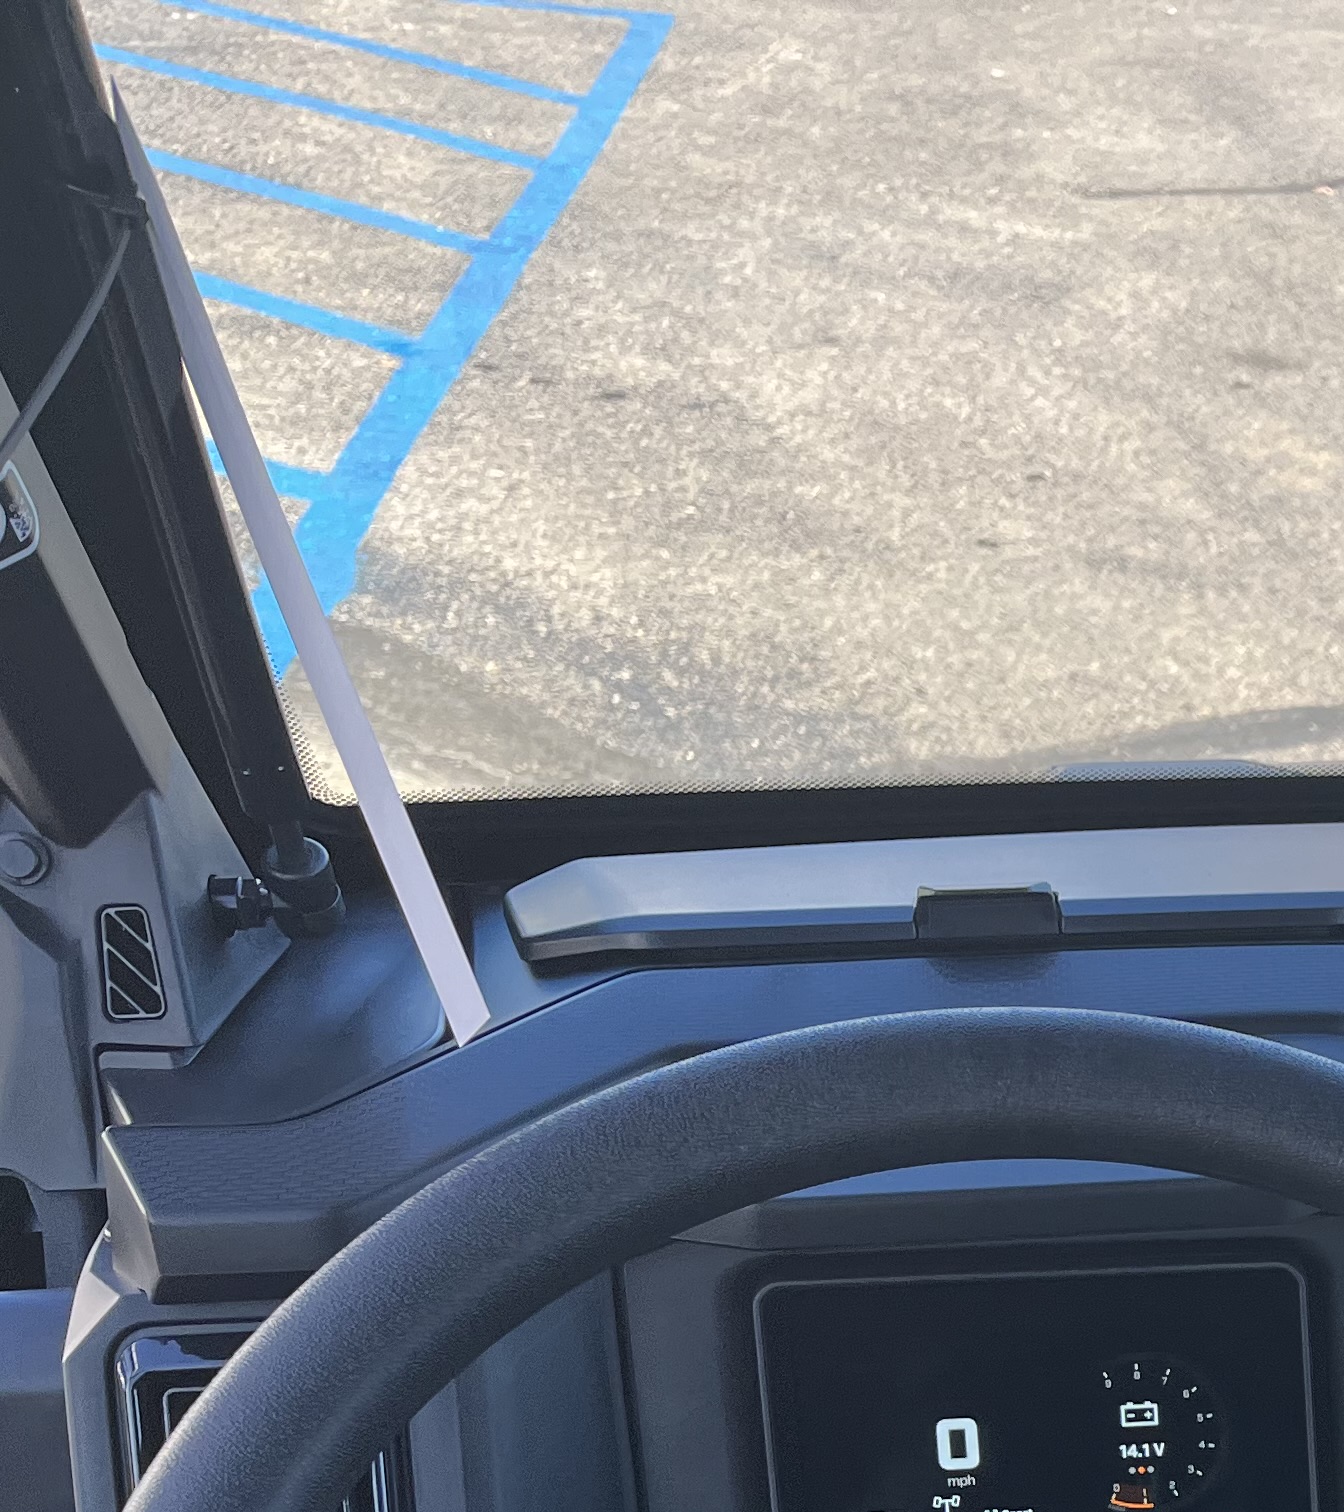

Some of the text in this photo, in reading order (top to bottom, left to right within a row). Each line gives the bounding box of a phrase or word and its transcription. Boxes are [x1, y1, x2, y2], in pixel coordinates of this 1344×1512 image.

[1161, 1376, 1168, 1386] 7
[936, 1417, 980, 1471] 0
[947, 1475, 976, 1489] mph
